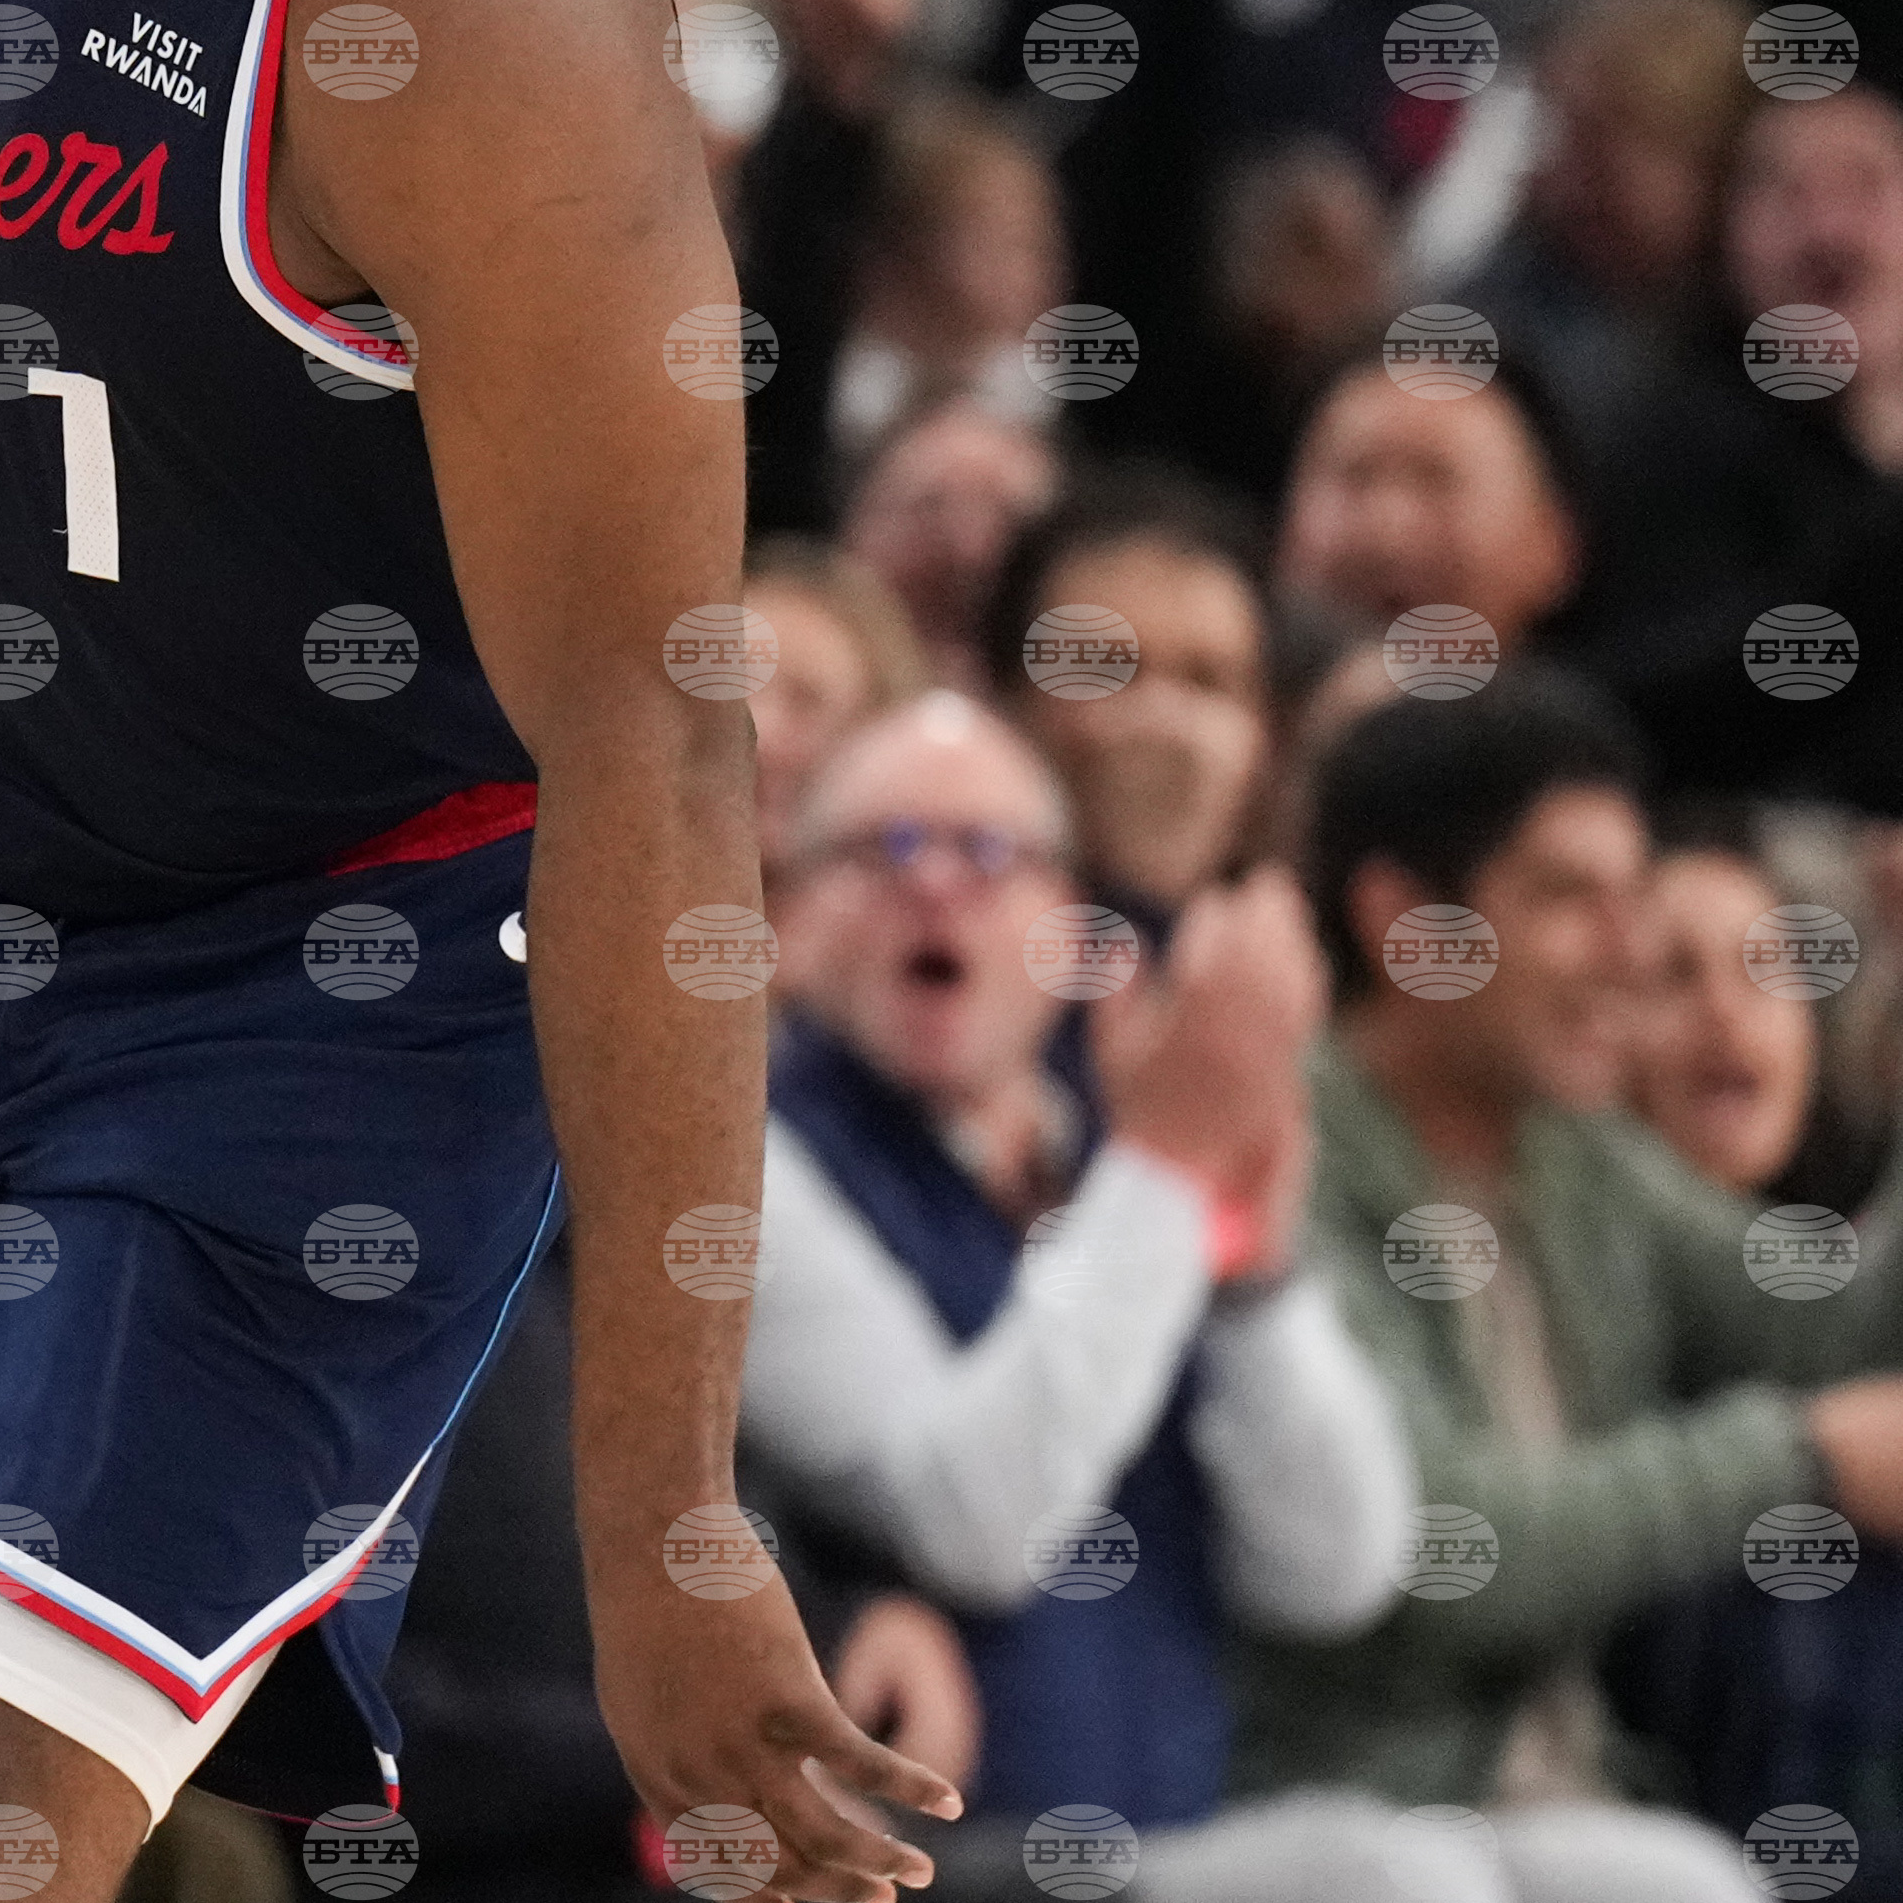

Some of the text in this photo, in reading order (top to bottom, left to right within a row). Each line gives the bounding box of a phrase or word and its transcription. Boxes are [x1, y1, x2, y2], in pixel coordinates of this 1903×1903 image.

[80, 28, 207, 118] RWANDA
[132, 12, 204, 72] VISIT
[27, 367, 120, 582] 1
